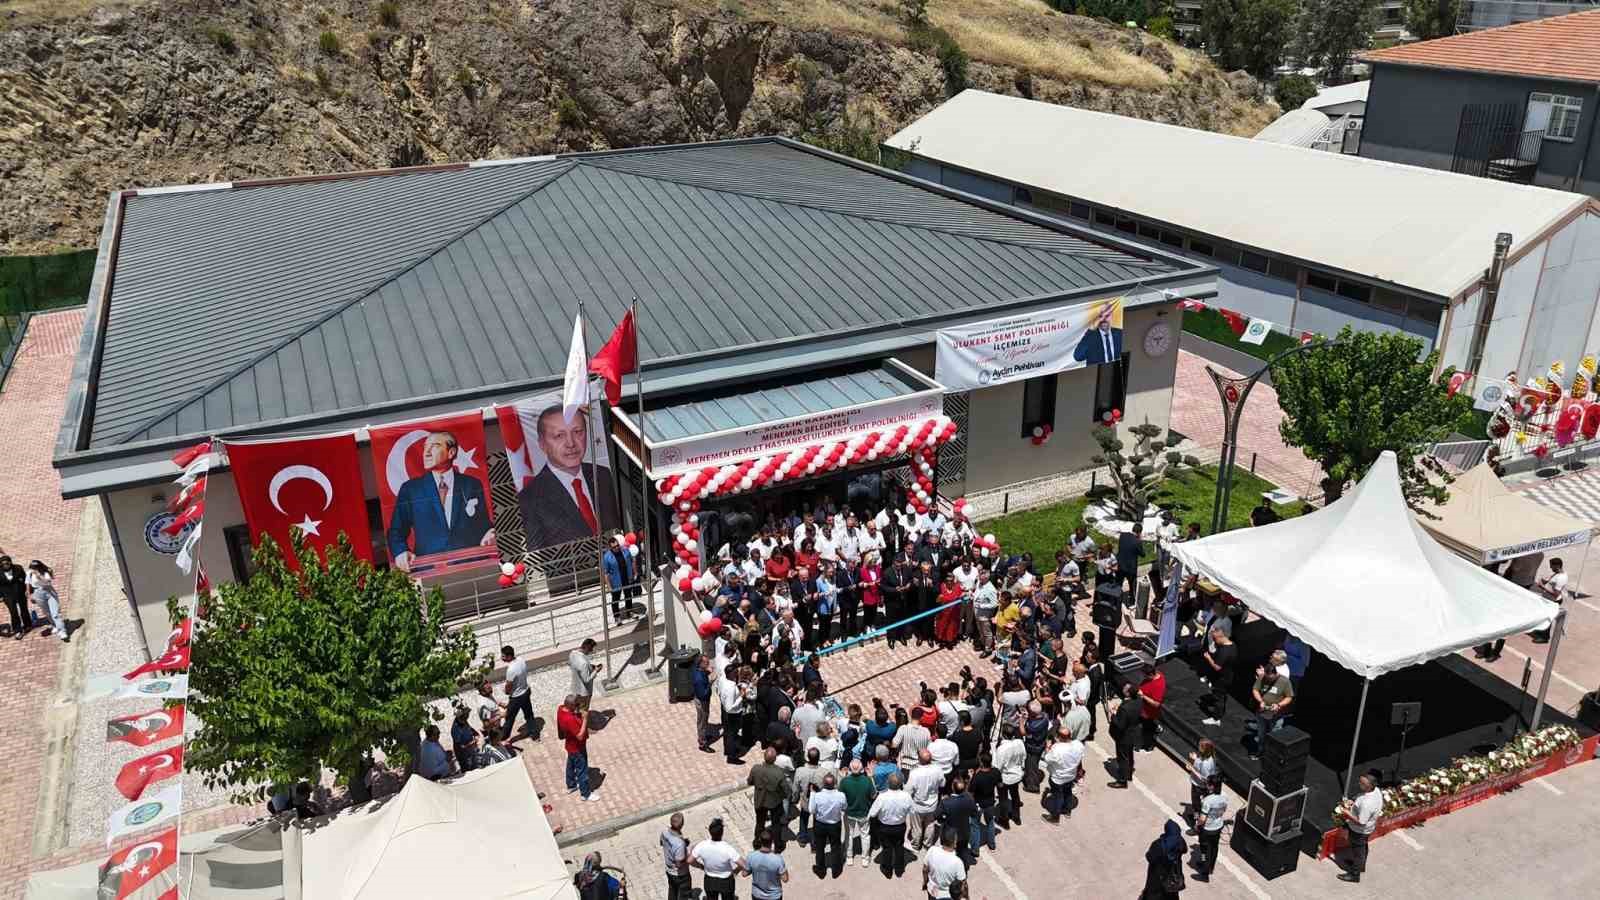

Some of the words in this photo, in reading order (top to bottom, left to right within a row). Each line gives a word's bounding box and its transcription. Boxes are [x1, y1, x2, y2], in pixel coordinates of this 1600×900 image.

[994, 331, 1016, 342] SEMT
[993, 337, 1031, 352] İLÇEMİZE
[992, 366, 1013, 377] Aydın
[761, 428, 802, 441] MENEMEN
[686, 451, 730, 464] MENEMEN
[732, 444, 762, 457] DEVLET
[849, 421, 870, 433] SEMT
[1502, 543, 1536, 556] MENEMEN
